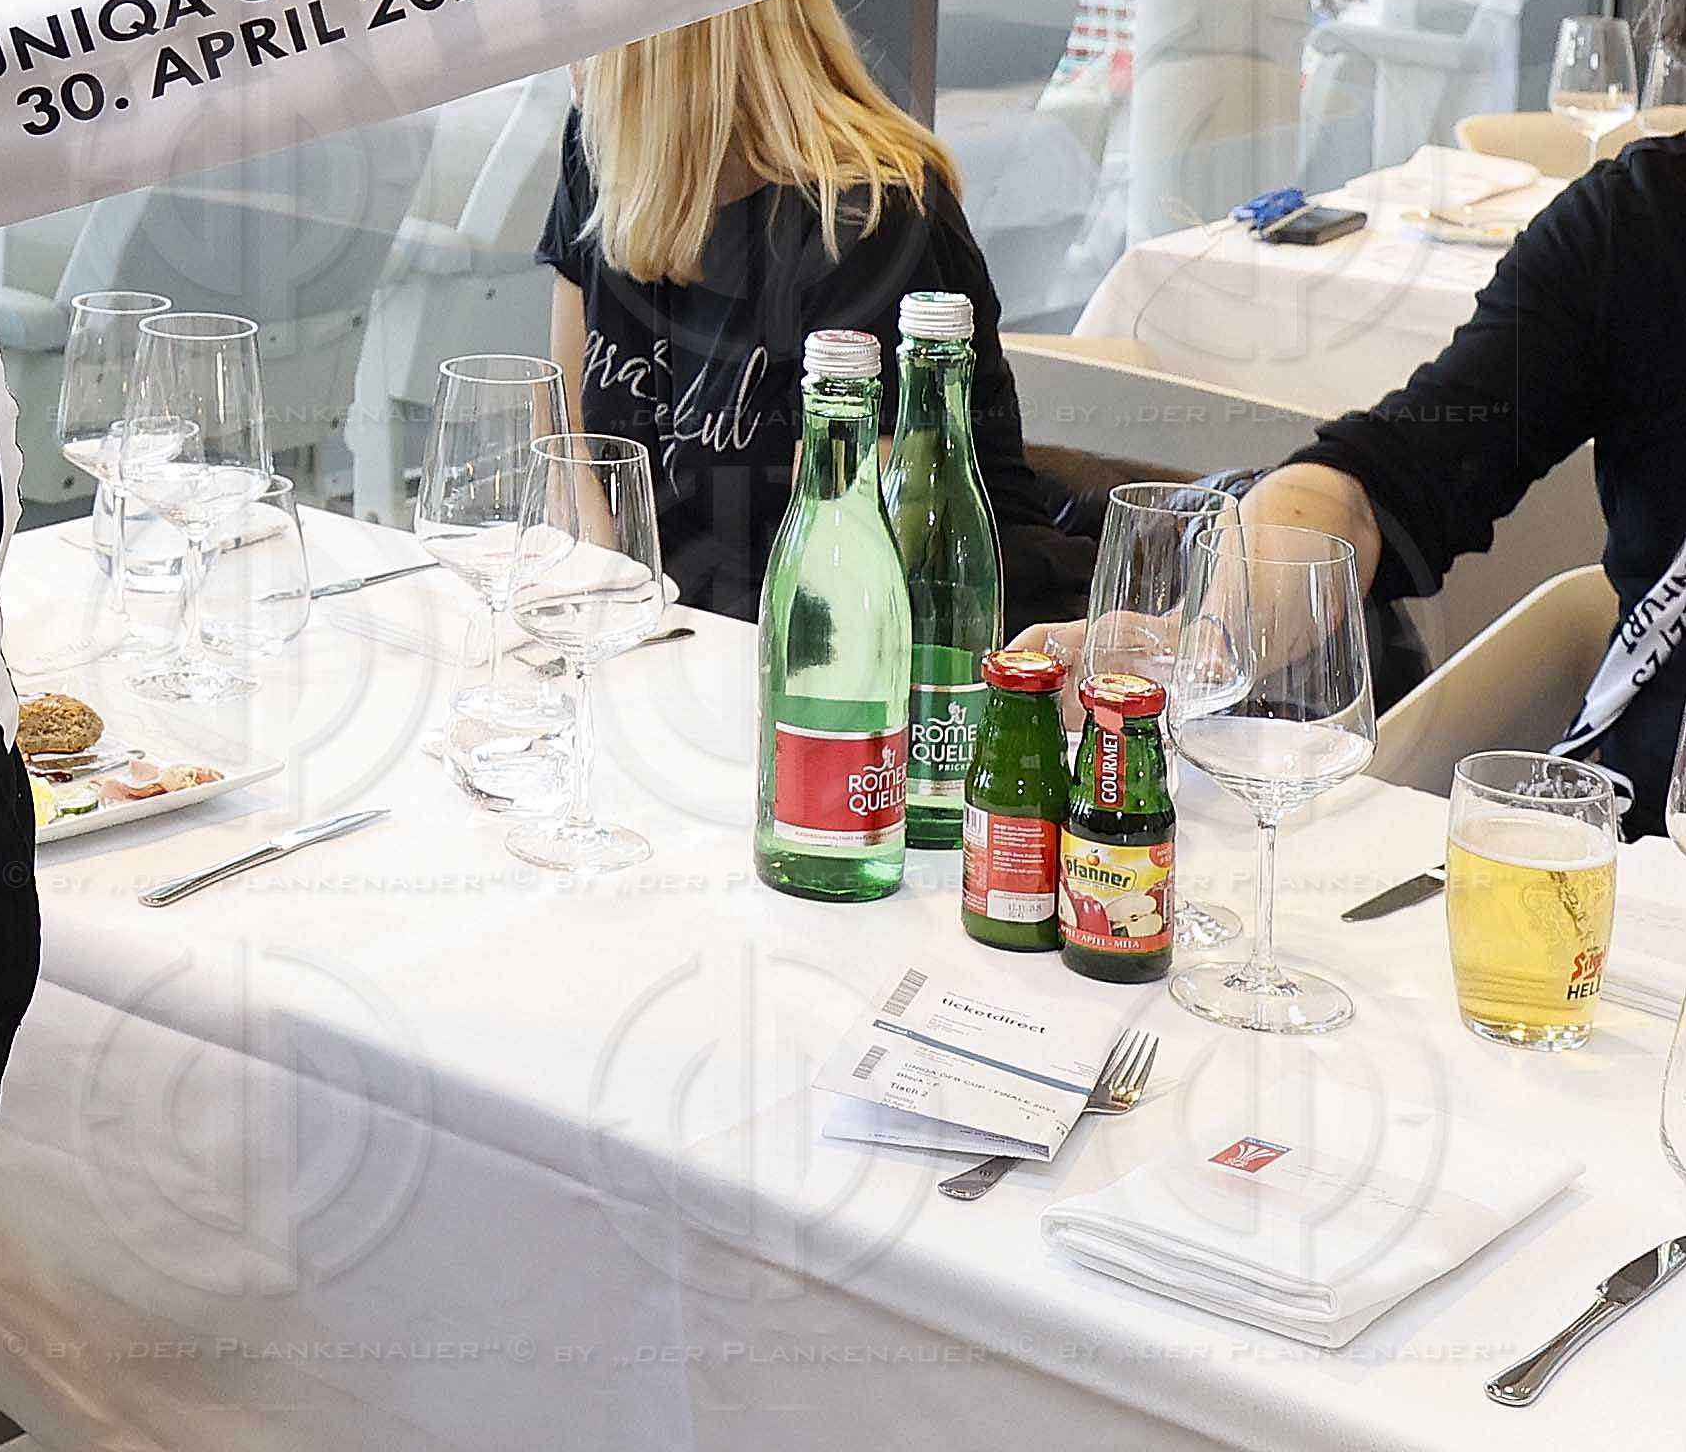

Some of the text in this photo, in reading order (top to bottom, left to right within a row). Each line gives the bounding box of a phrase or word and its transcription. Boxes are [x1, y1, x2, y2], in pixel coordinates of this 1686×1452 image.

[17, 70, 130, 136] 30.
[151, 0, 347, 100] APRIL
[1101, 732, 1120, 804] GOURMET
[1065, 857, 1132, 890] pfanner
[941, 996, 1047, 1035] ticketdirect
[889, 1081, 919, 1096] Tisch
